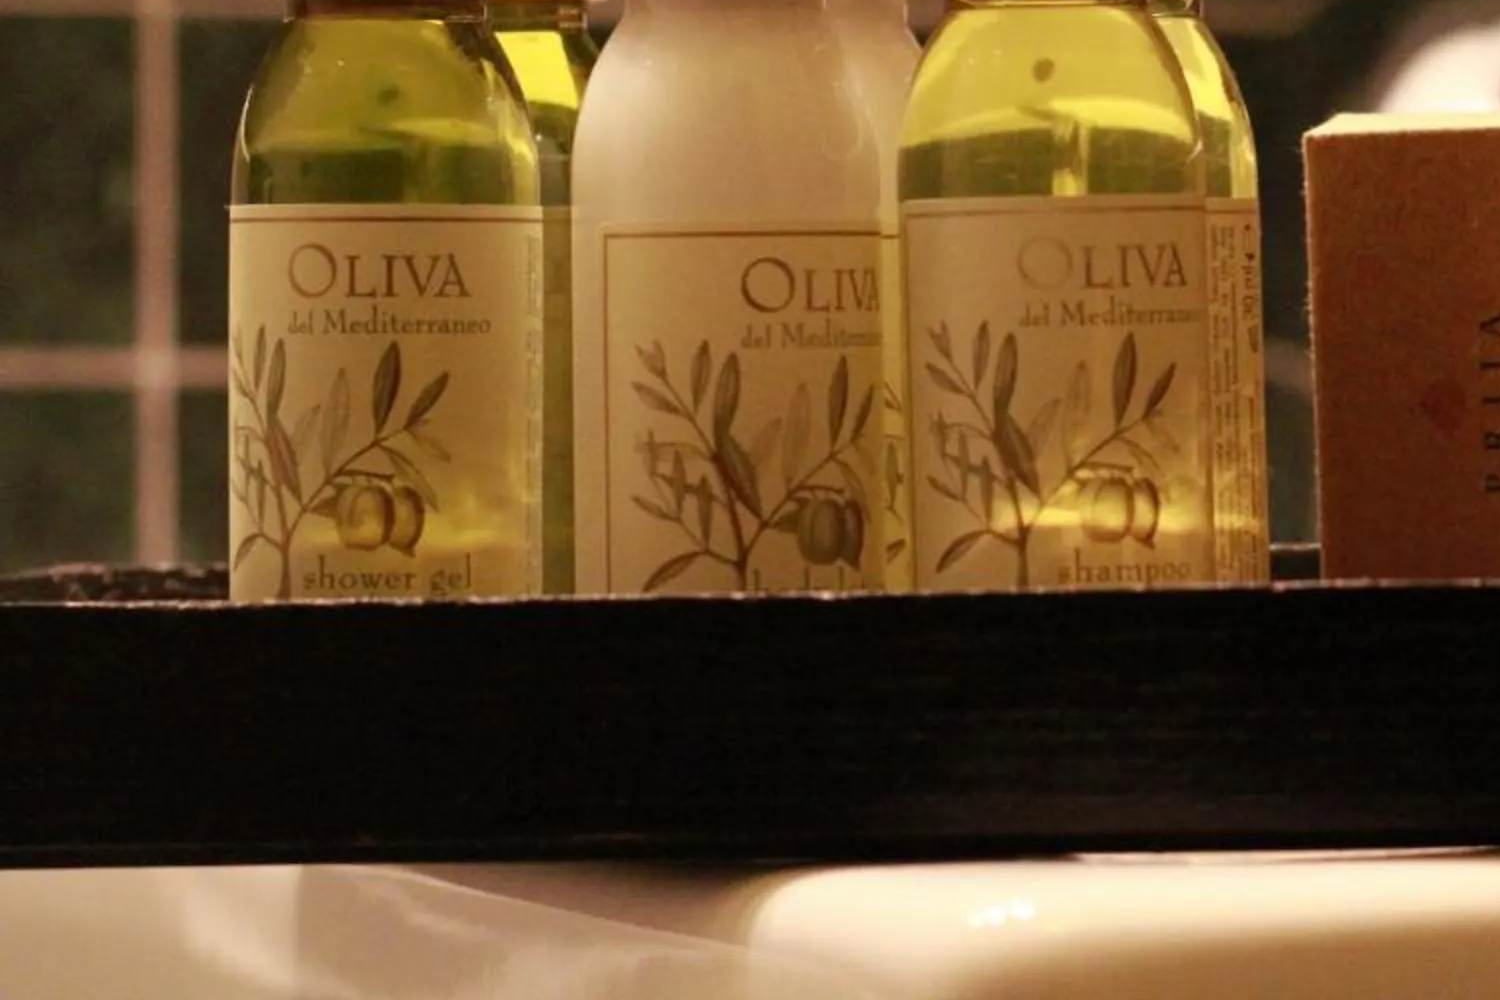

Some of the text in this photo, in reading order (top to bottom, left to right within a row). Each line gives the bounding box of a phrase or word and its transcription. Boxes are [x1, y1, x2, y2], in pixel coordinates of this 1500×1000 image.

[287, 242, 472, 299] OLIVA
[287, 304, 492, 335] del Mediterraneo
[303, 552, 473, 597] shower gel
[1057, 546, 1191, 587] shampoo
